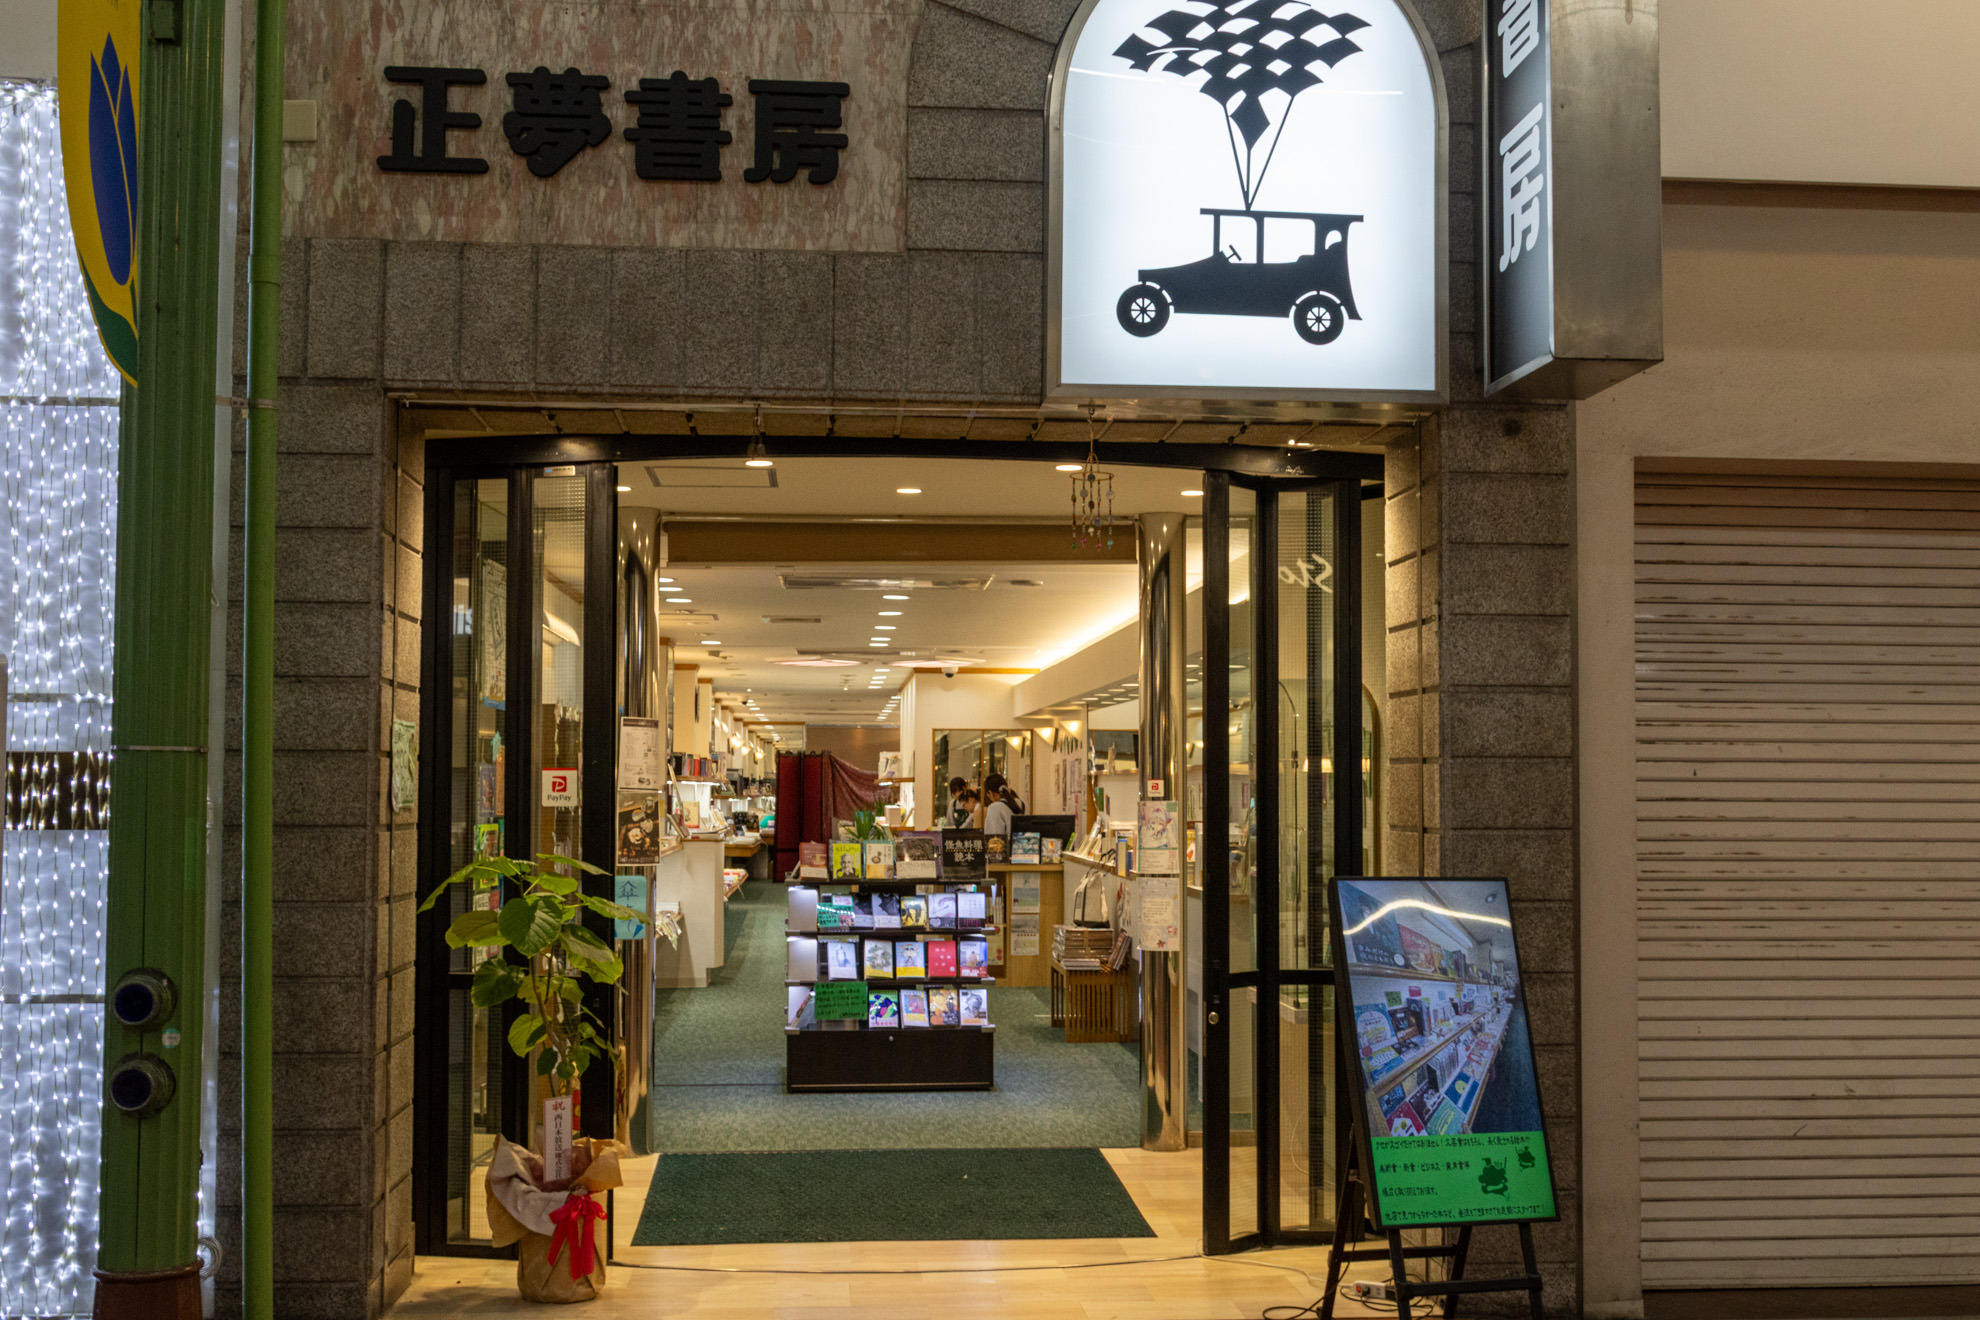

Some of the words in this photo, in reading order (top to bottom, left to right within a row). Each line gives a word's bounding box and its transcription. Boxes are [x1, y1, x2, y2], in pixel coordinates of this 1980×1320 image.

[376, 66, 850, 185] 正夢書房
[547, 794, 572, 802] PayPay
[552, 1101, 566, 1111] 祝
